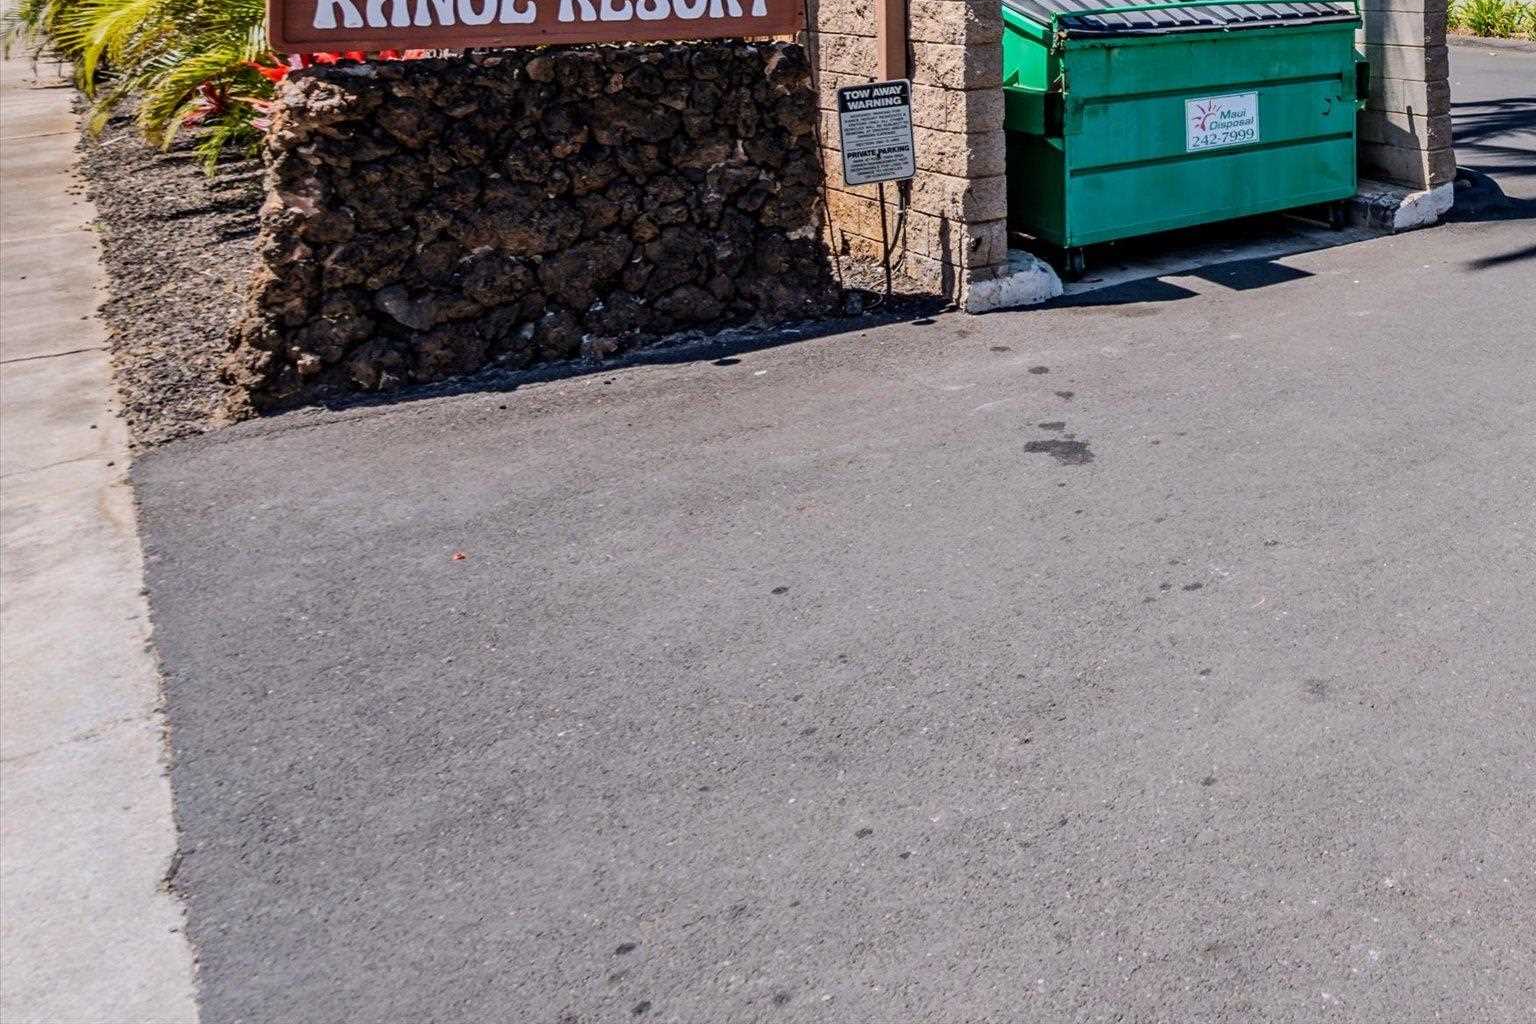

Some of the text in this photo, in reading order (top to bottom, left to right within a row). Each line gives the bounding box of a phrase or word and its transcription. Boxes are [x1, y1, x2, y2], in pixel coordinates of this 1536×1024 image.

[843, 86, 903, 100] TOW AWAY
[847, 97, 902, 110] WARNING
[1220, 109, 1246, 119] Maui
[1209, 116, 1254, 131] Disposal
[1192, 128, 1255, 147] 242-7999
[847, 145, 909, 159] PRIVATE PARKING
